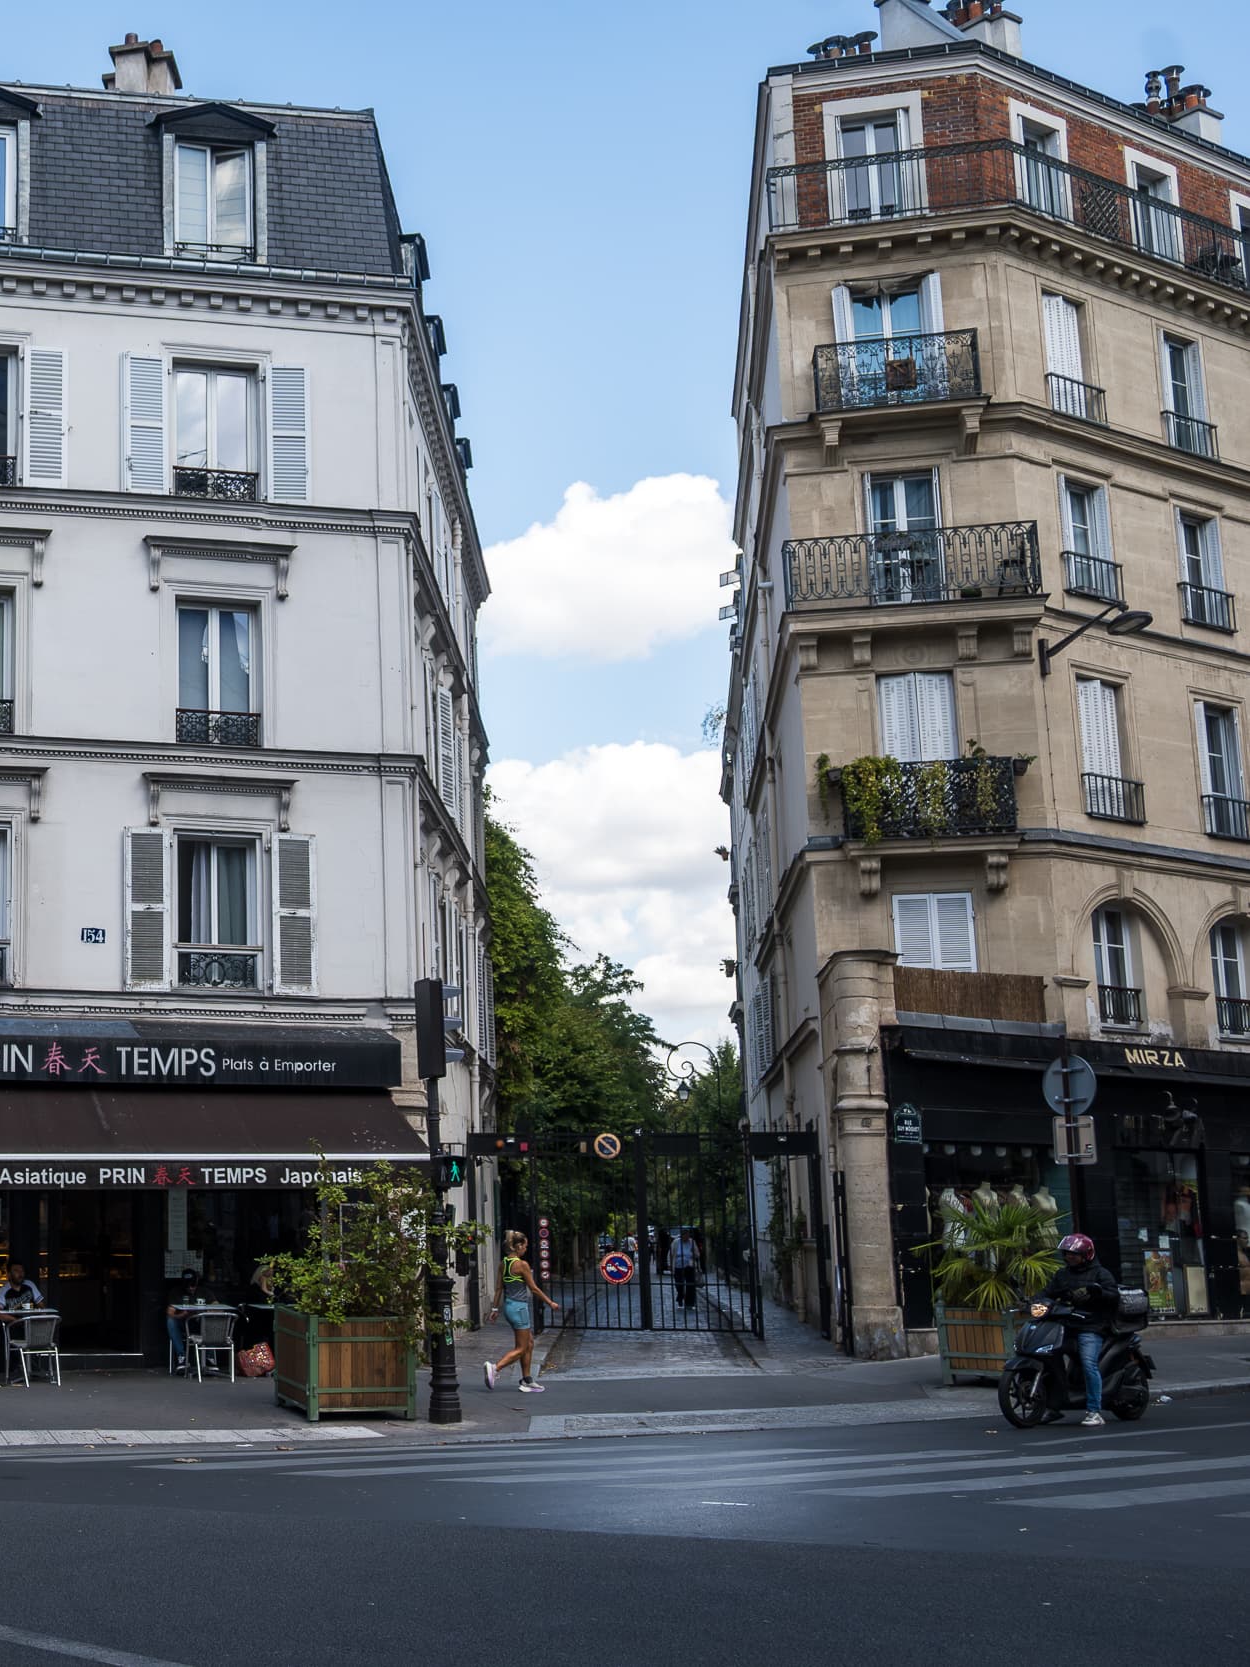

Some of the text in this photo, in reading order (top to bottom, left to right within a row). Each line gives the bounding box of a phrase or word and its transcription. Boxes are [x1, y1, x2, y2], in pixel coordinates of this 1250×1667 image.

[83, 929, 104, 942] 154
[41, 1042, 107, 1076] 春天
[117, 1046, 216, 1076] TEMPS
[223, 1058, 253, 1071] Plats
[259, 1057, 269, 1071] à
[274, 1059, 337, 1073] Emporter
[1125, 1048, 1186, 1067] MIRZA
[0, 1168, 87, 1188] Asiatique
[100, 1168, 145, 1184] PRIN
[153, 1164, 197, 1187] 春天
[201, 1167, 267, 1184] TEMPS
